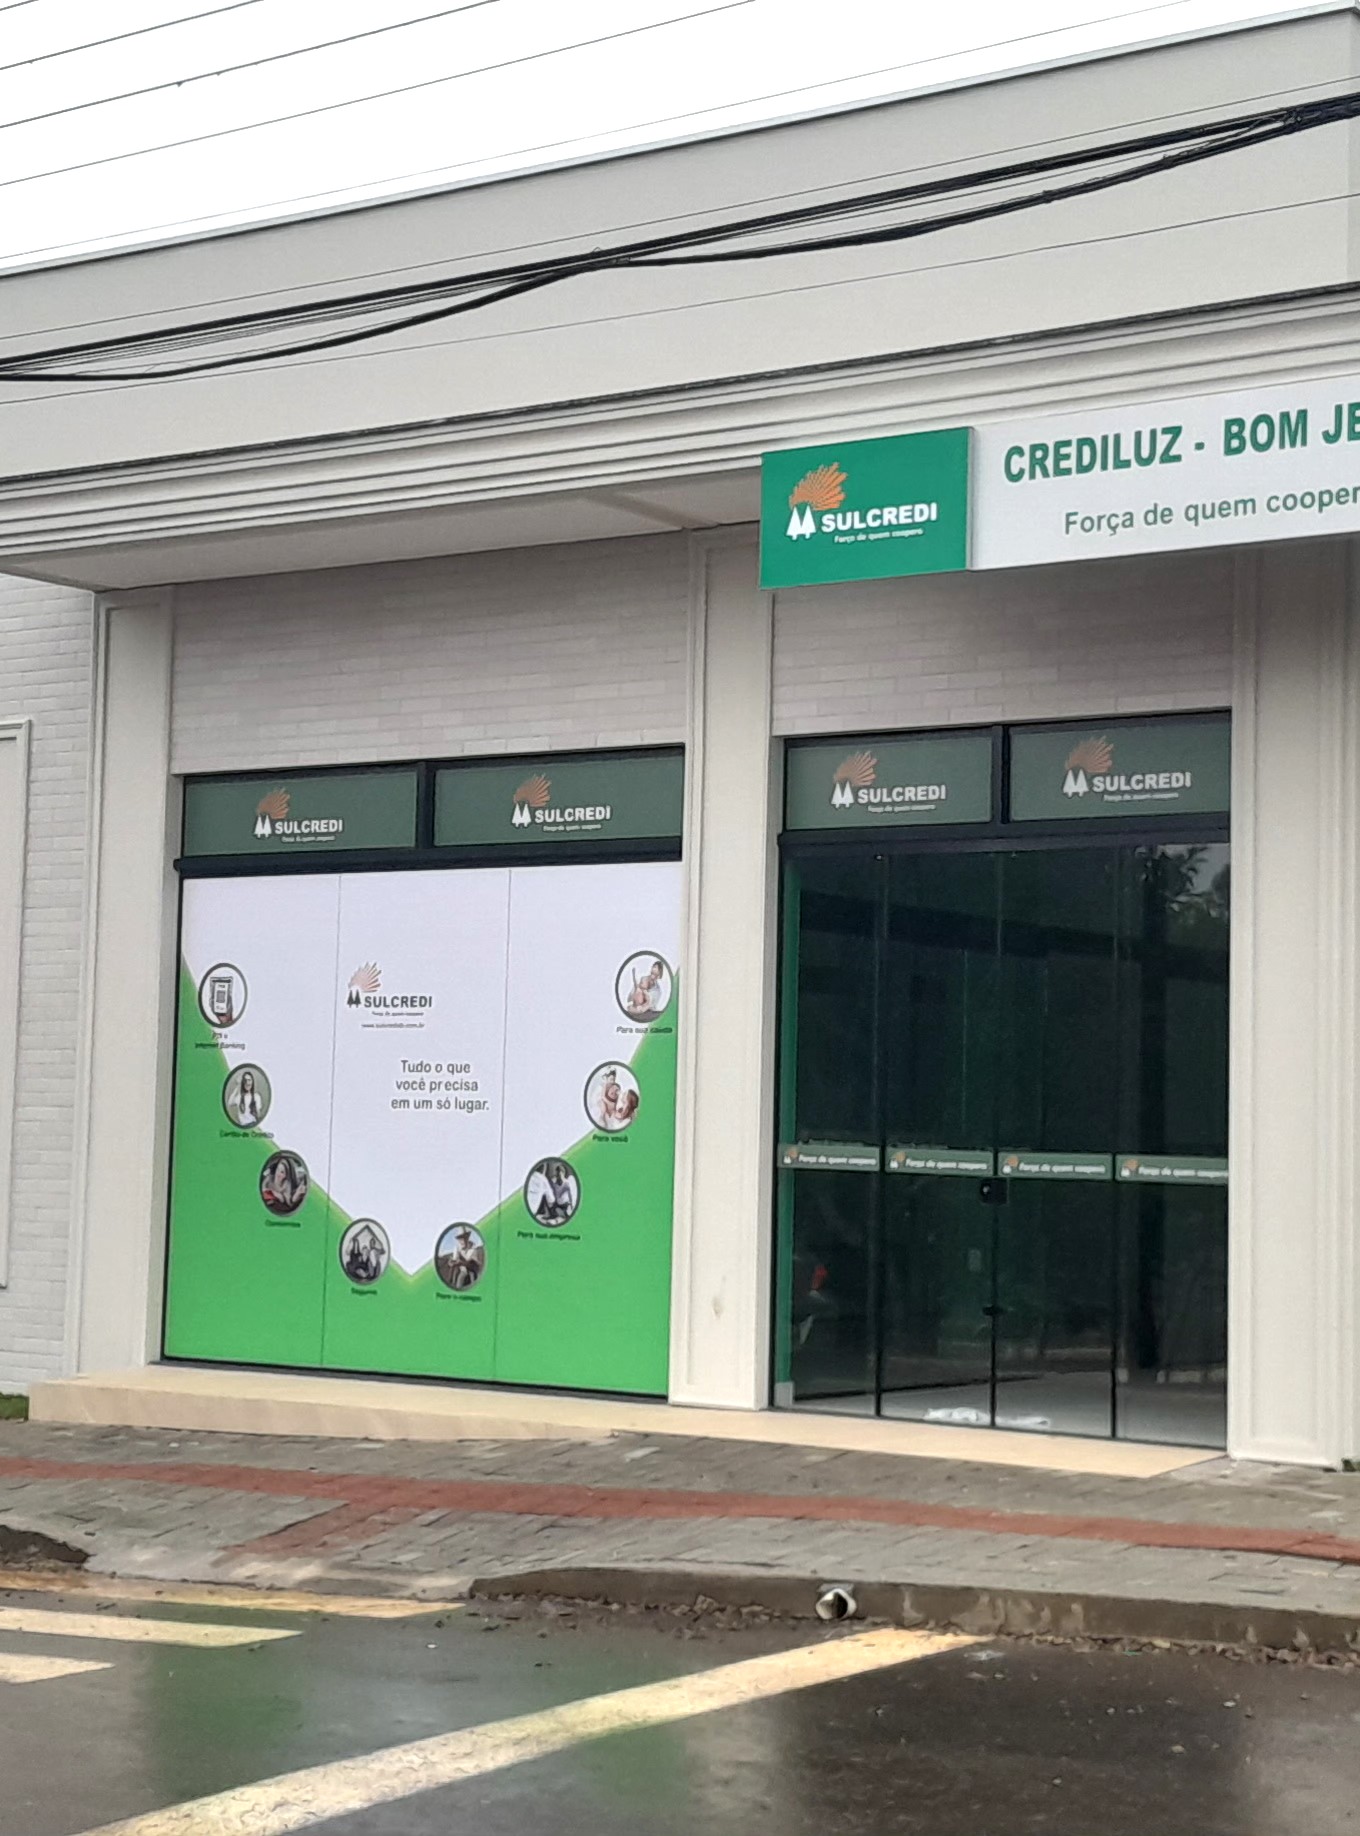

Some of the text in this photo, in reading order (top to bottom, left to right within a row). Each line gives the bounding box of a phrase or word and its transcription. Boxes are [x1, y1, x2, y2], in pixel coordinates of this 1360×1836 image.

[1004, 425, 1183, 483] CREDILUZ
[1223, 408, 1309, 457] BOM
[821, 502, 938, 533] SULCREDI
[1065, 511, 1134, 537] Força
[1143, 503, 1174, 527] de
[1184, 497, 1256, 524] quem
[1092, 772, 1193, 794] SULCREDI
[857, 784, 947, 804] SULCREDI
[535, 805, 612, 825] SULCREDI
[275, 818, 344, 835] SULCREDI
[364, 995, 433, 1008] SULCREDI
[401, 1059, 471, 1076] Tudo o que
[395, 1077, 479, 1093] você precisa
[390, 1096, 490, 1113] em um só lugar.
